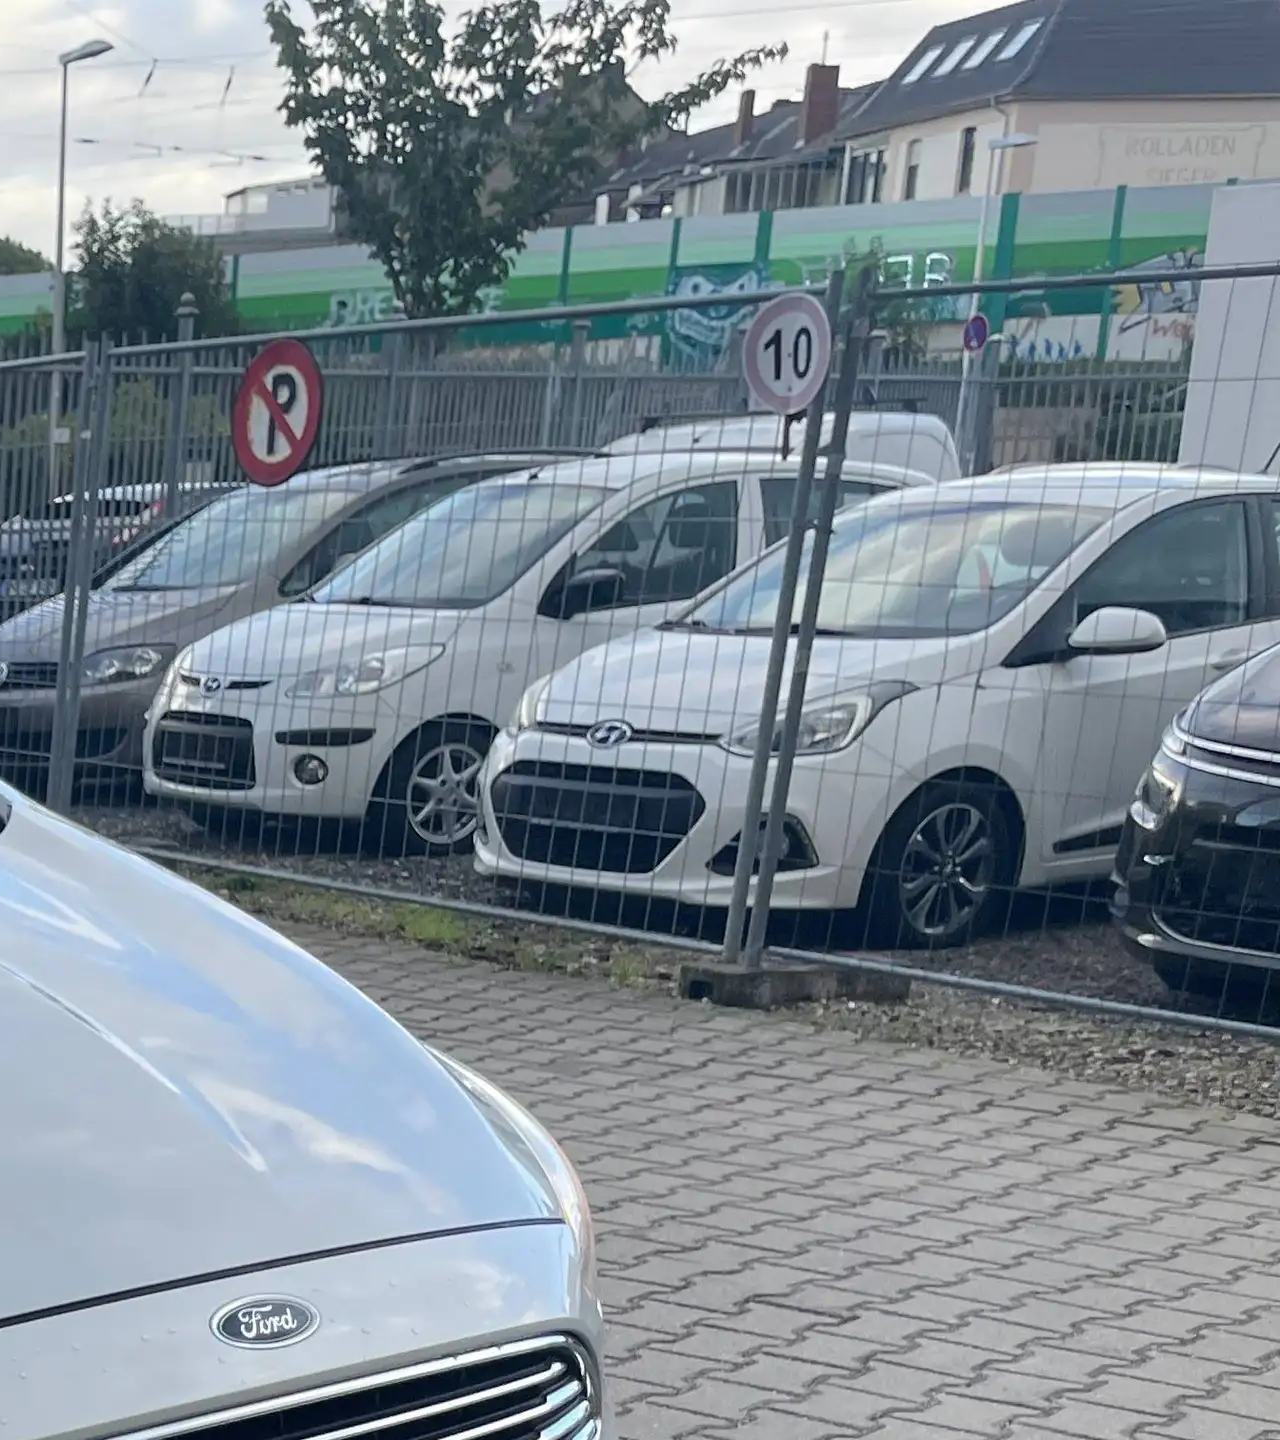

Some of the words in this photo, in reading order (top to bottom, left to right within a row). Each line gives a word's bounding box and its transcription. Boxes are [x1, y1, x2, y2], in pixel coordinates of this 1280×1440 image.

[1125, 135, 1236, 157] ROLLADEN
[763, 326, 812, 380] 10
[266, 373, 296, 456] P
[238, 1304, 297, 1338] Ford
